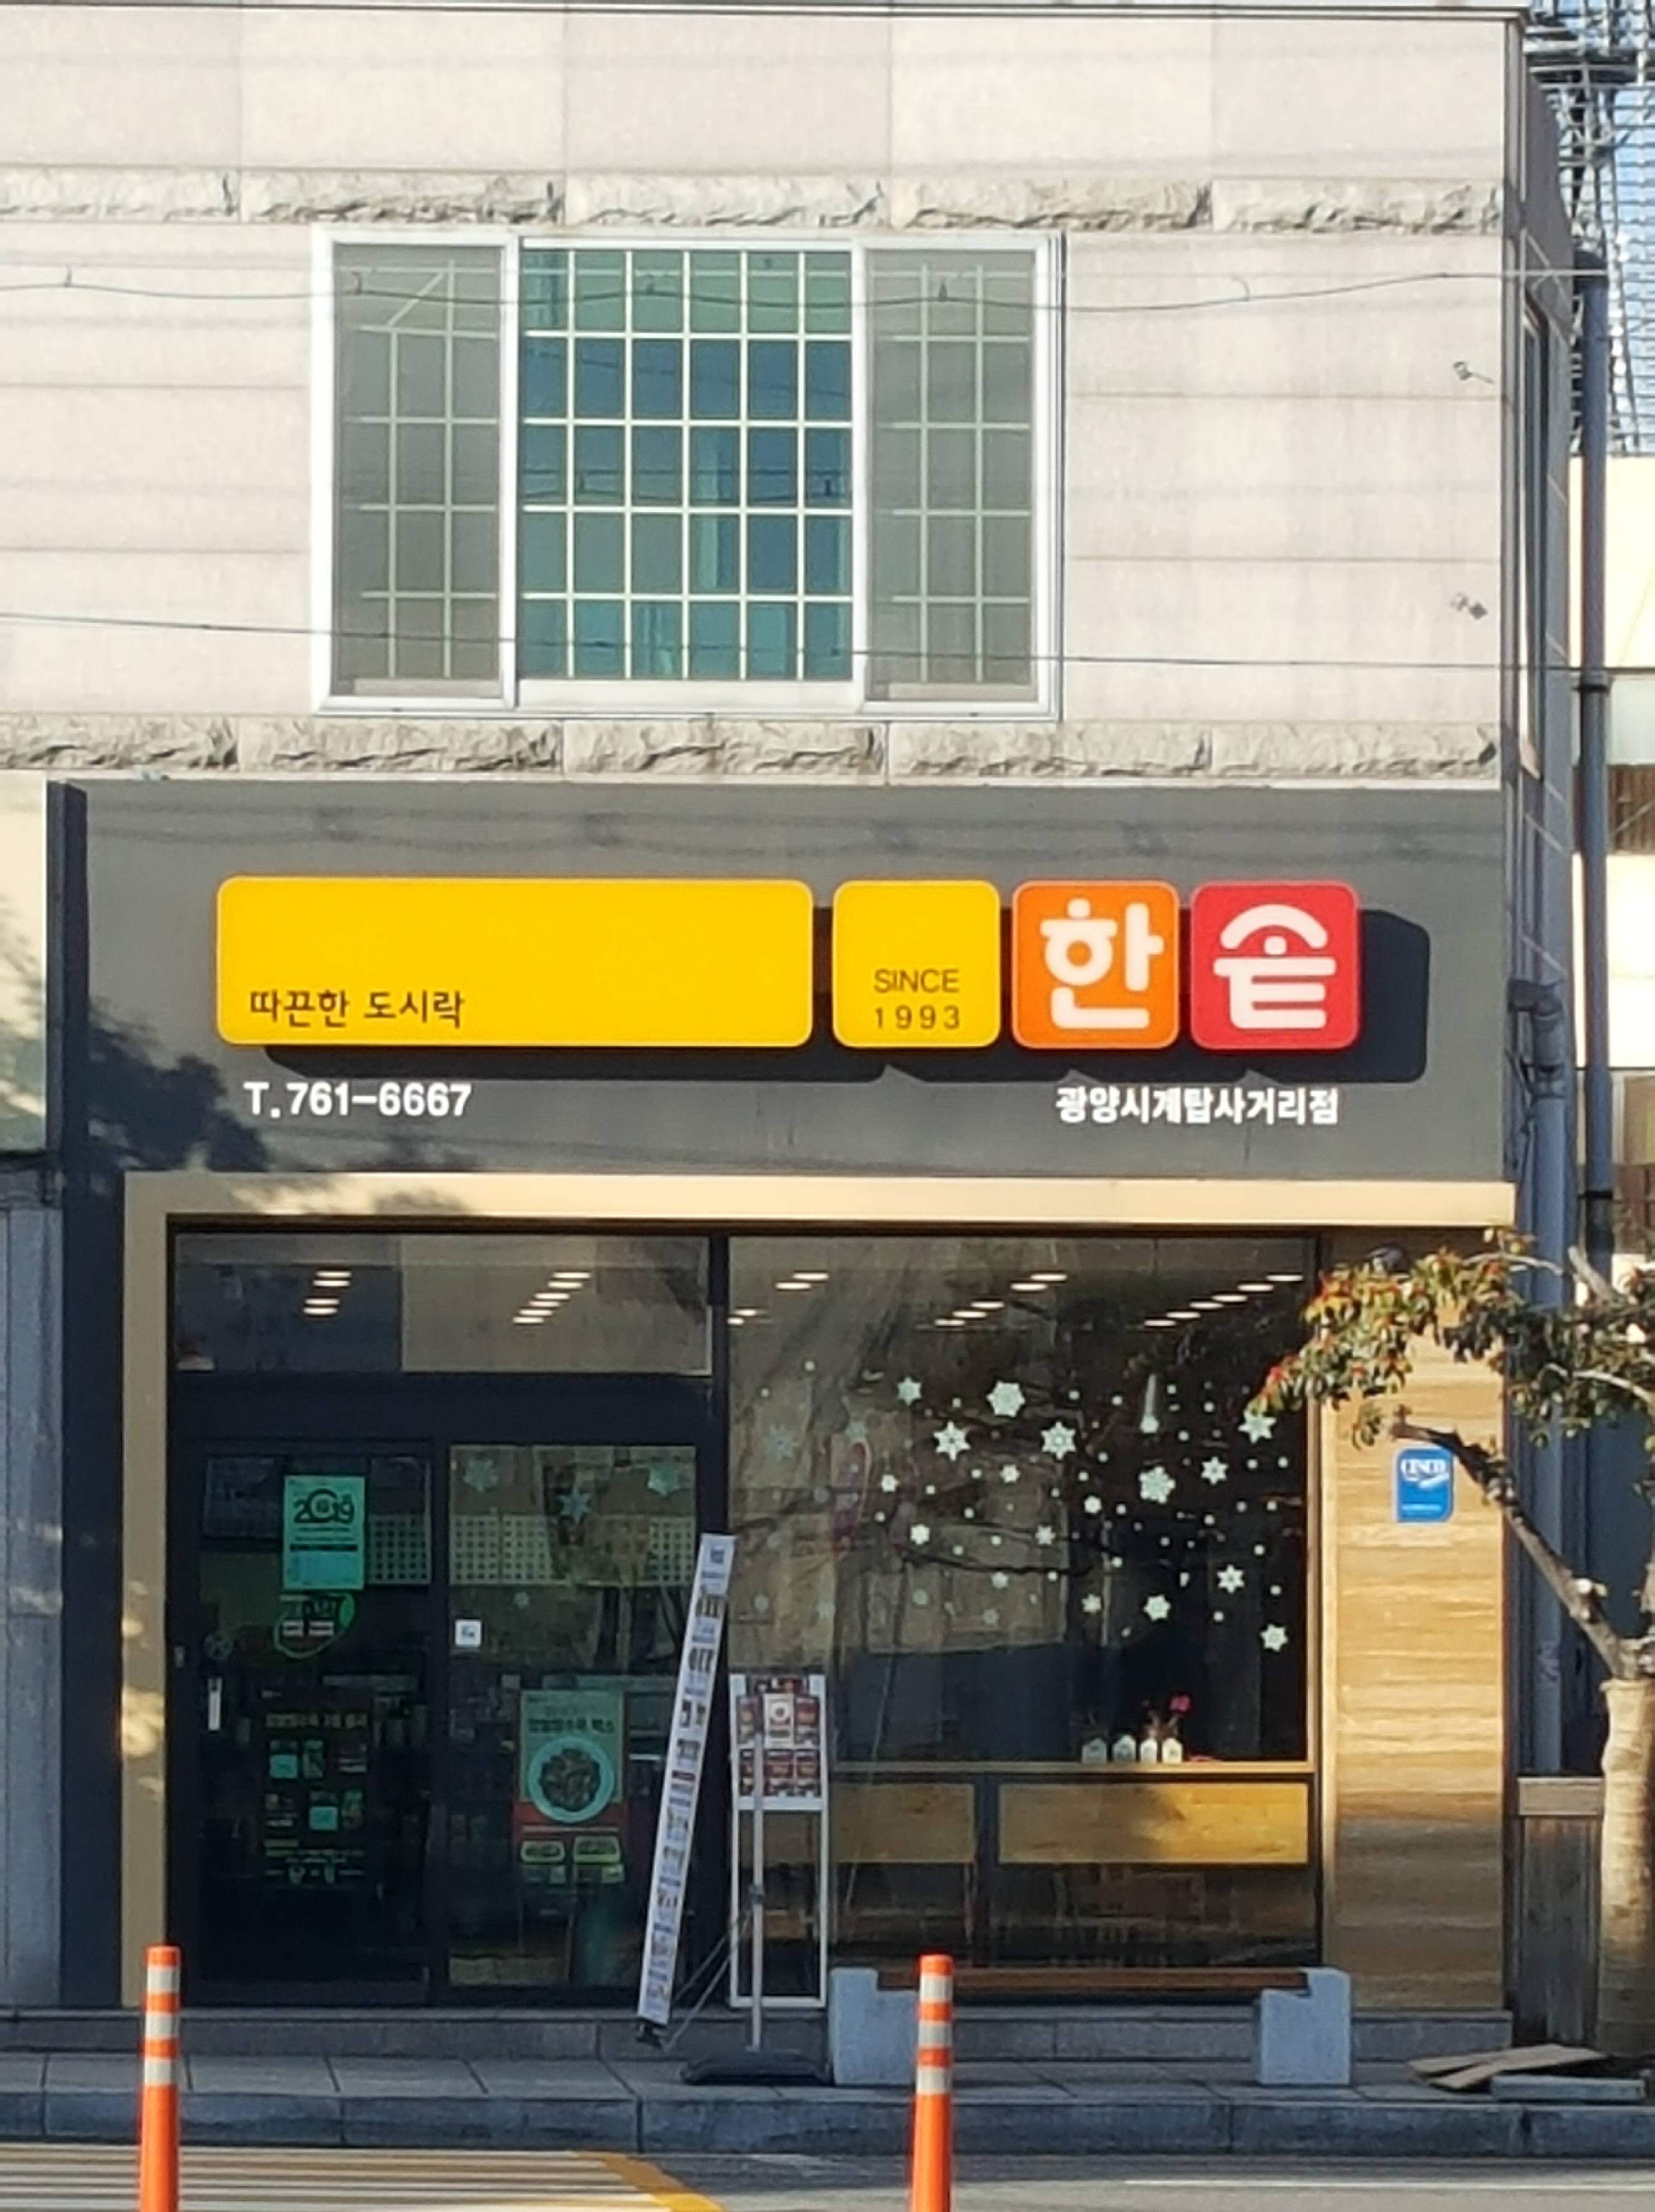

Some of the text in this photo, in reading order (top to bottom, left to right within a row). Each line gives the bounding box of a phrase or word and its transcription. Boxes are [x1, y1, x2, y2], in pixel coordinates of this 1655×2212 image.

[874, 969, 959, 994] SINCE
[1040, 898, 1336, 1029] 한솥
[250, 990, 465, 1029] 따끈한 도시락
[874, 1006, 960, 1029] 1993
[243, 1081, 472, 1118] T.761-6667
[1056, 1086, 1339, 1125] 광양시계탑사거리점
